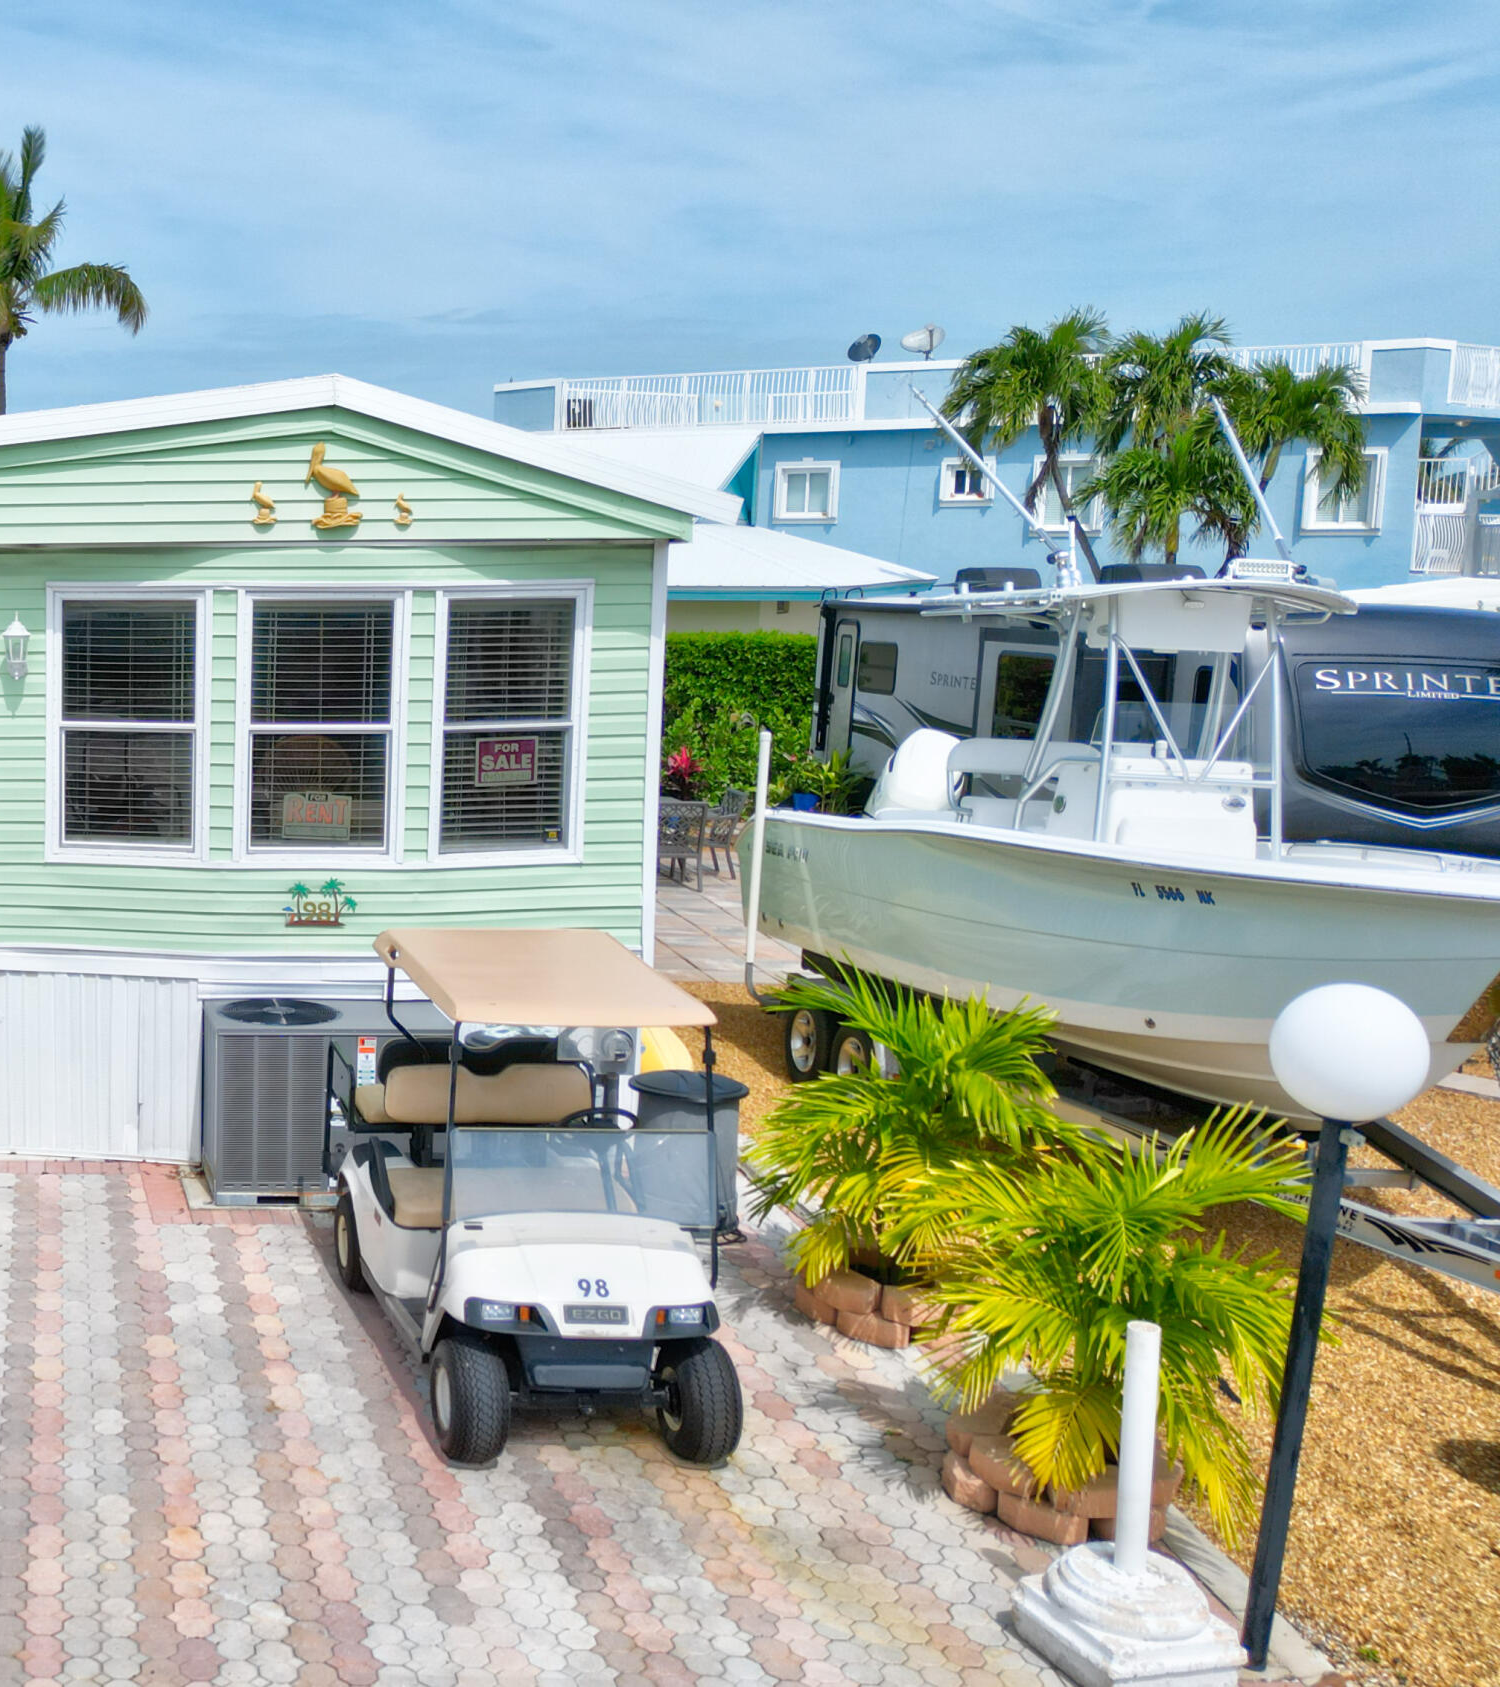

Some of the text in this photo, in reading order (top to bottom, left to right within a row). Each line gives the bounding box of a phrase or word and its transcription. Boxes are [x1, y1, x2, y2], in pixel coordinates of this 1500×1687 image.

[930, 671, 977, 690] SPRINTE
[1316, 669, 1500, 695] SPRINTE
[1407, 690, 1460, 700] LIMITED
[494, 743, 520, 753] FOR
[481, 753, 533, 771] SALE
[285, 797, 349, 825] RENT
[303, 901, 332, 922] 98
[577, 1278, 610, 1298] 98
